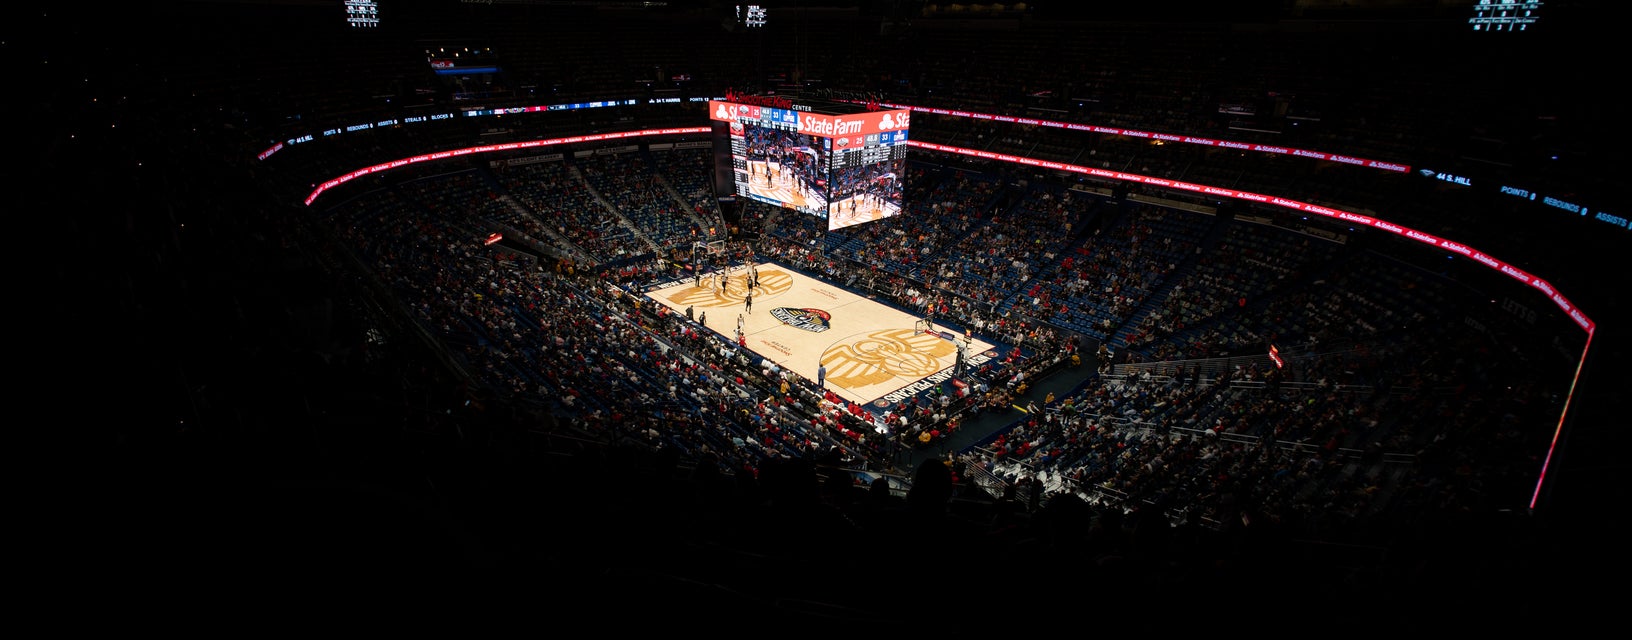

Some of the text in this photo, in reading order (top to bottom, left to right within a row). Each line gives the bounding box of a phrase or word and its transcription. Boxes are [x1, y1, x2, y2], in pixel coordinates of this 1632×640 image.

[1454, 176, 1472, 186] HILL
[1500, 186, 1536, 201] POINTS 0
[1543, 197, 1588, 216] REBOUNDS 0
[1595, 212, 1627, 227] ASSISTS
[884, 380, 935, 403] PELICANS
